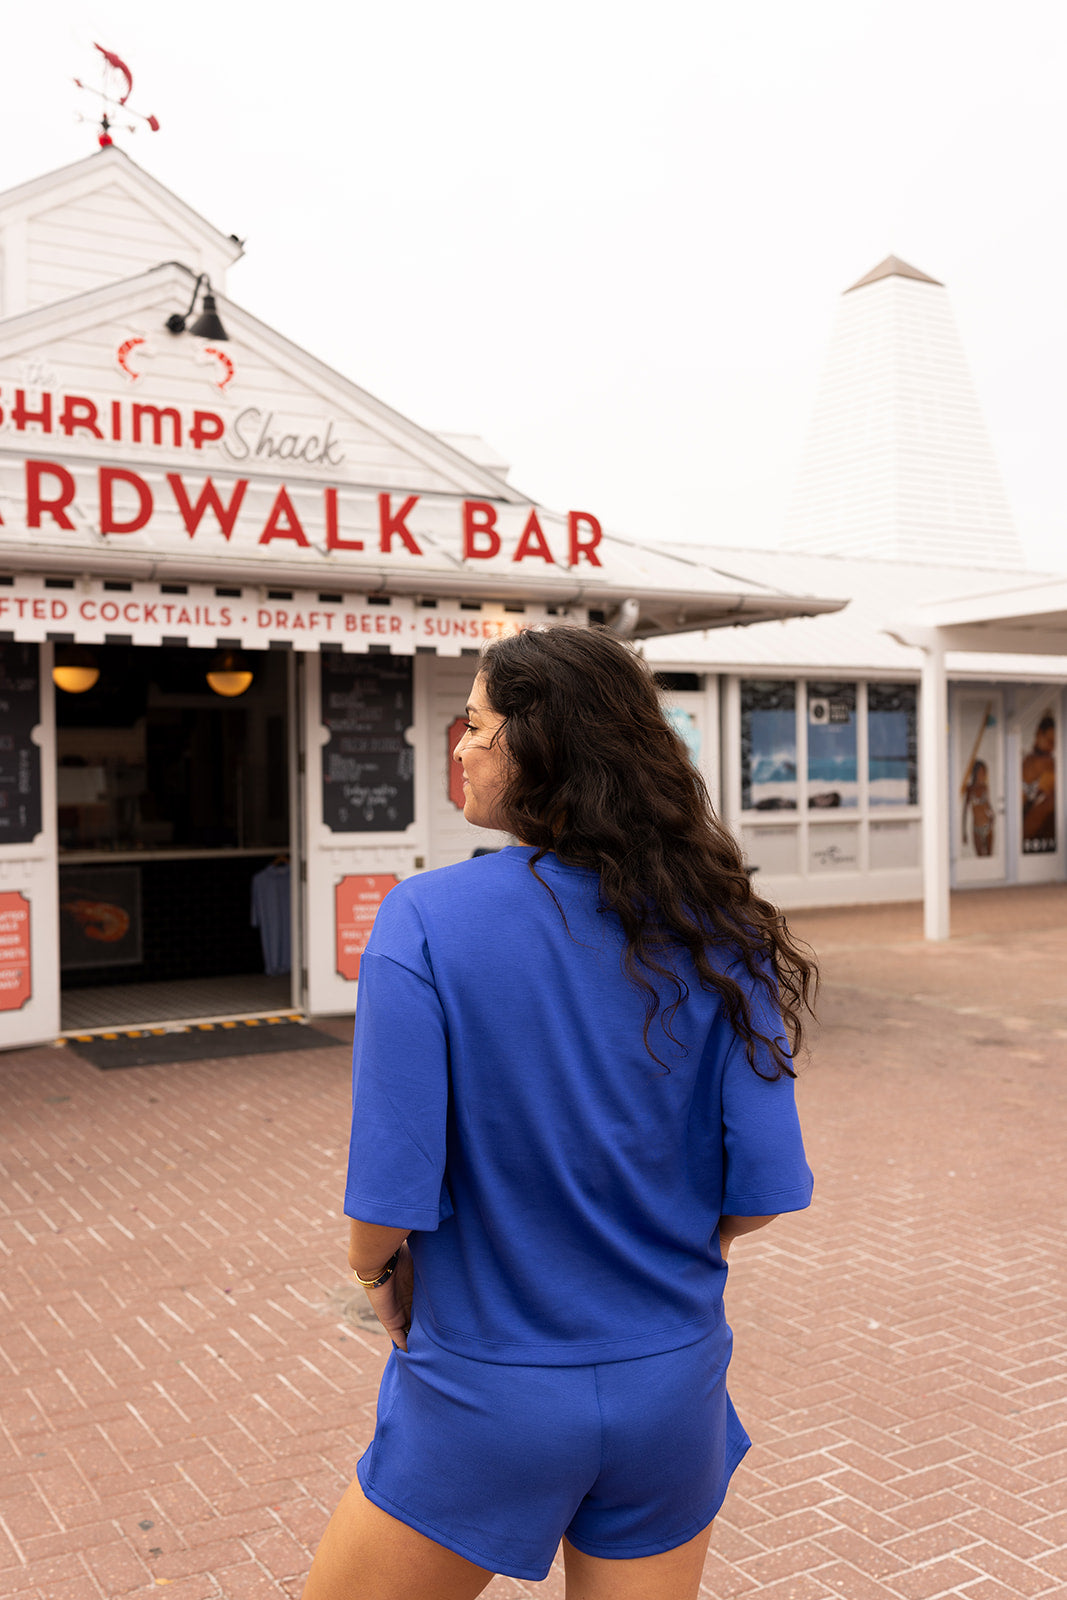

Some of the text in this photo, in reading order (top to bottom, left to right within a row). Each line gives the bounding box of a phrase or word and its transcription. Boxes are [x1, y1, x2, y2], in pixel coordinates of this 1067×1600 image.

[0, 387, 346, 466] HRIMP Shack
[0, 460, 603, 568] RDWALK BAR
[79, 600, 233, 627] COCKTAILS
[257, 609, 403, 634] DRAFT BEER
[424, 617, 505, 640] SUNSET
